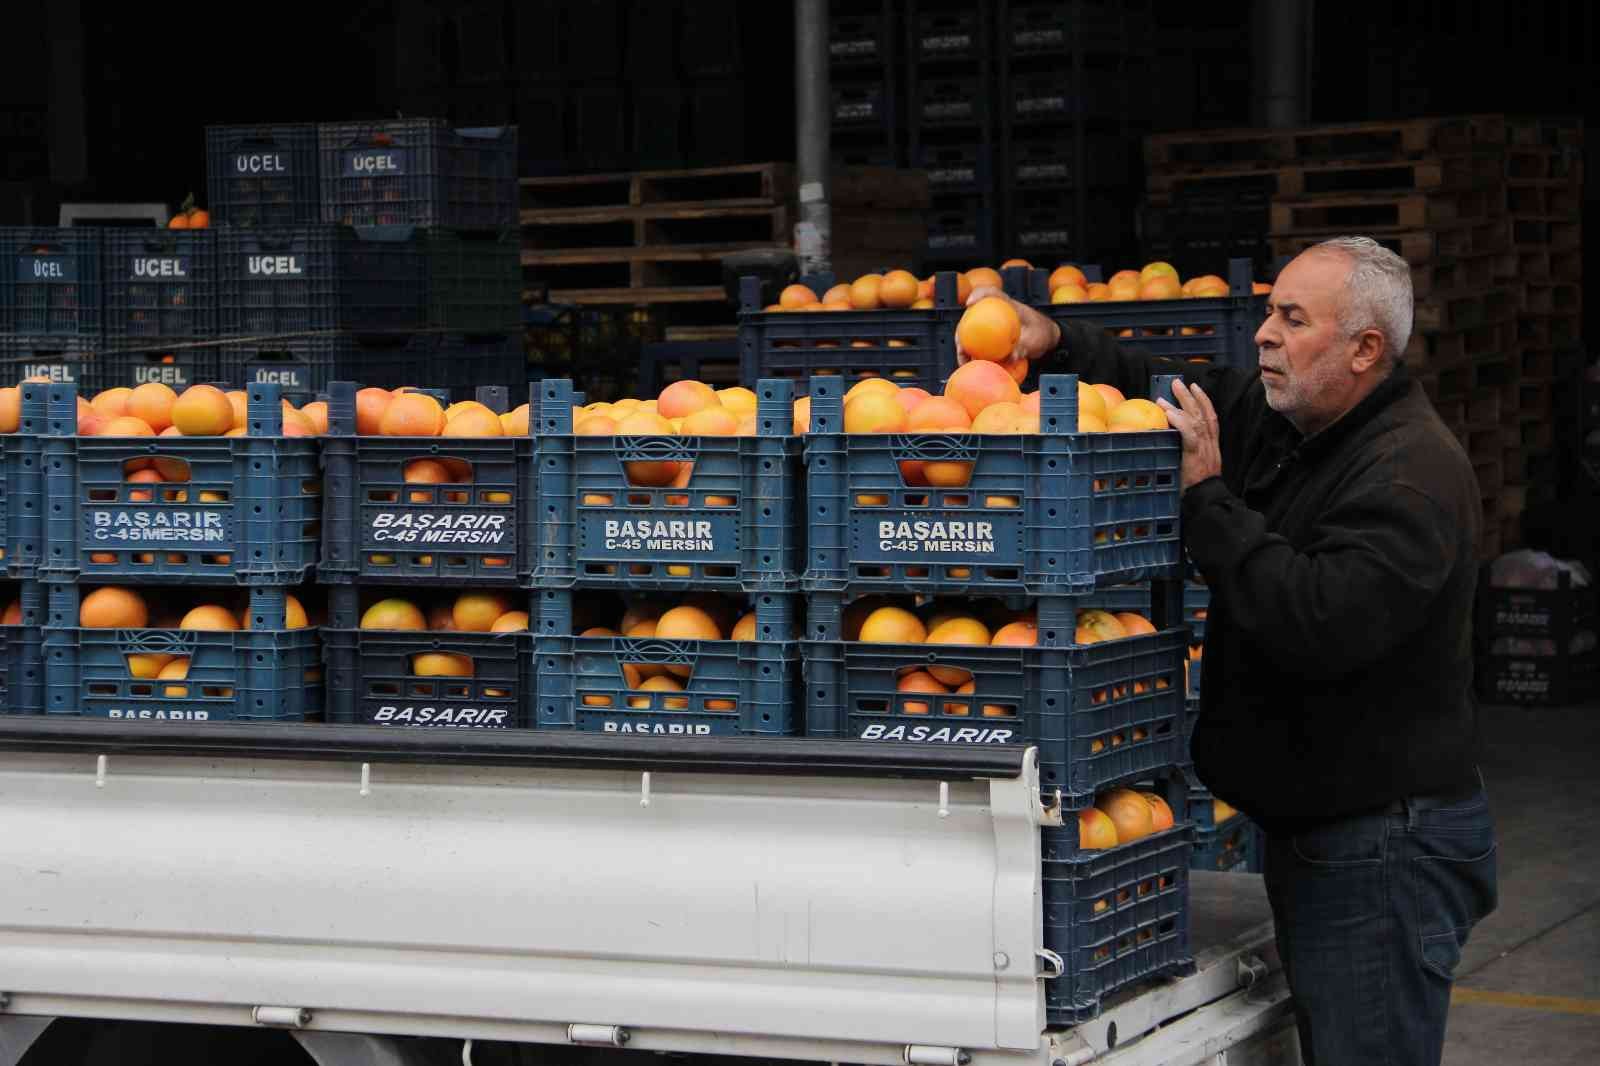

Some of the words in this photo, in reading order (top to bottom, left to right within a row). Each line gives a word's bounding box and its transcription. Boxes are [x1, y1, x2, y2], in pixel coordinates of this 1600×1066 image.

[372, 513, 506, 530] BAŞARIR
[373, 530, 418, 543] C-45
[605, 520, 713, 539] BAŞARIR
[605, 538, 642, 550] C-45
[879, 540, 919, 552] C-45
[374, 706, 508, 724] BAŞARIR
